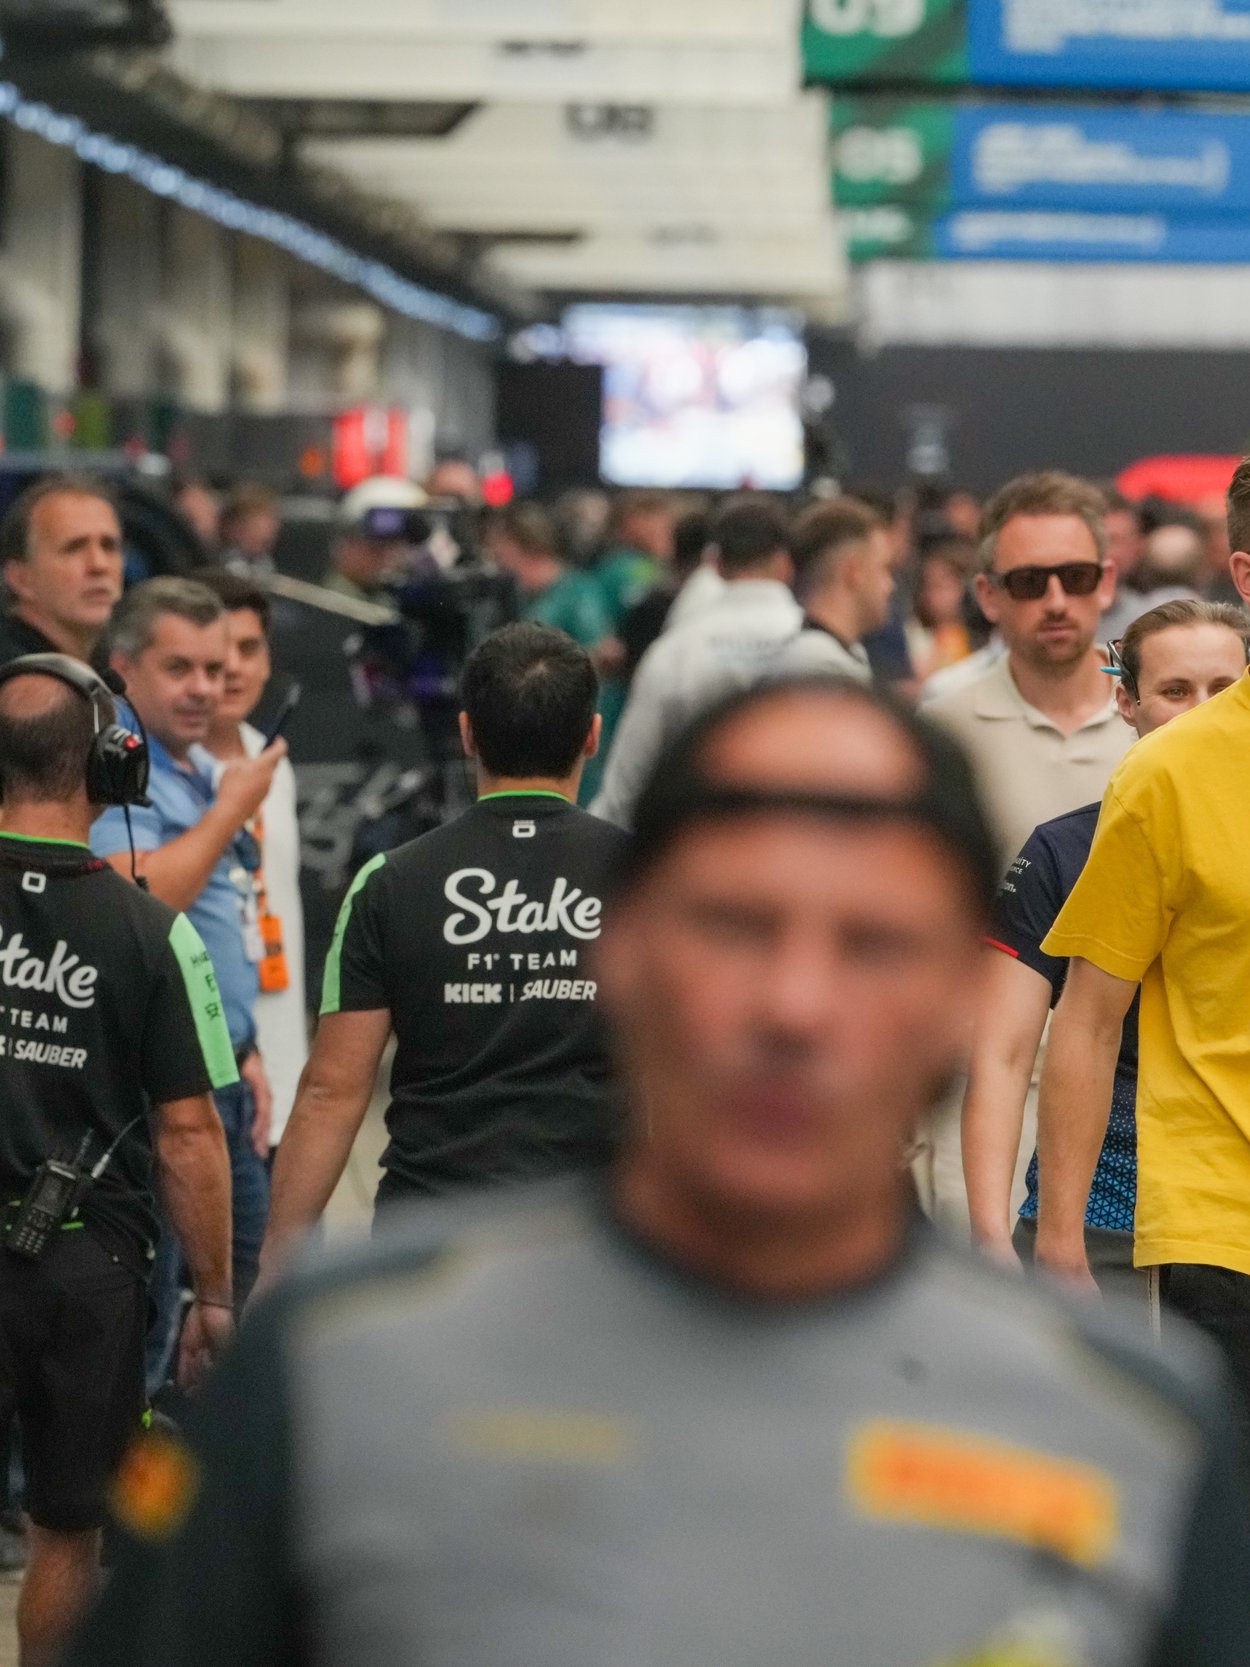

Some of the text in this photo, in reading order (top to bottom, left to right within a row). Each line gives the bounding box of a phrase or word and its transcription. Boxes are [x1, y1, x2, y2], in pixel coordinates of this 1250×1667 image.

[443, 867, 602, 945] Stake
[0, 924, 98, 1009] take
[510, 949, 577, 970] TEAM
[444, 979, 597, 1003] KICK SAUBER
[10, 1008, 68, 1034] TEAM
[14, 1038, 88, 1069] SAUBER
